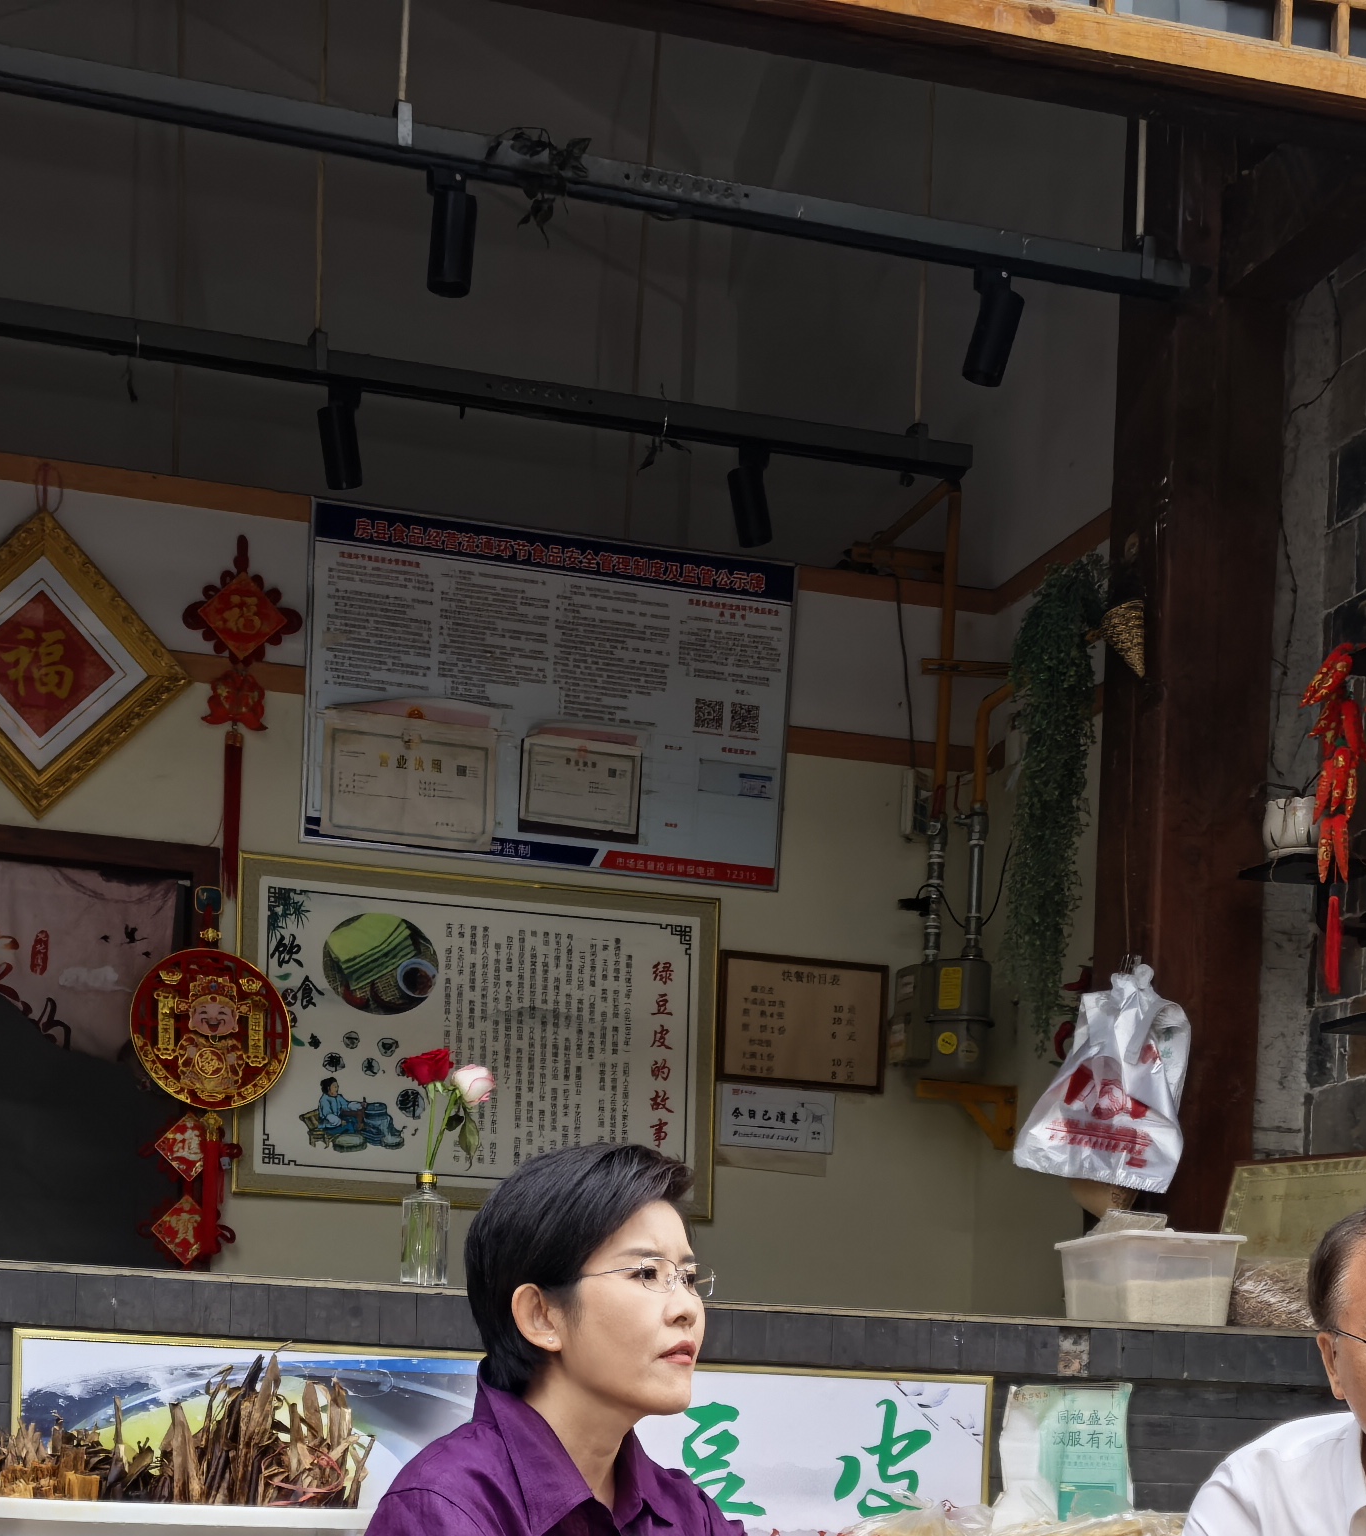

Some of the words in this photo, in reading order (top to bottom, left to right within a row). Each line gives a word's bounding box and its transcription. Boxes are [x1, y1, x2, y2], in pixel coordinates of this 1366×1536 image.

[354, 518, 766, 593] 房县食品经营流通环节食品安全管理制度及监管公示牌
[1, 625, 75, 700] 福
[378, 752, 443, 774] 营业执照
[616, 857, 716, 878] 市场监督投诉举报电话
[782, 970, 841, 986] 快餐价目表
[731, 1107, 802, 1125] 今日已消毒
[1057, 1409, 1119, 1426] 同袍盛会
[1053, 1430, 1124, 1449] 汉服有礼
[681, 1398, 933, 1518] 豆皮
